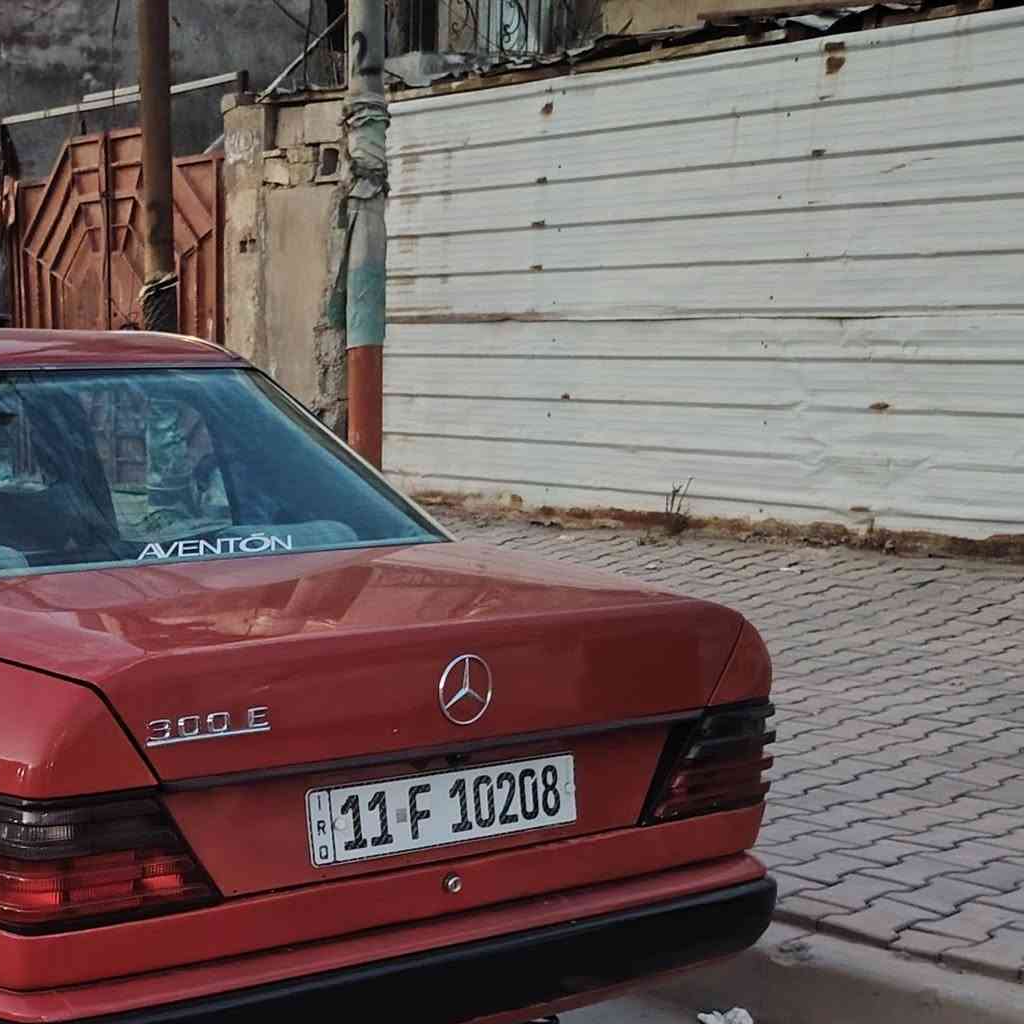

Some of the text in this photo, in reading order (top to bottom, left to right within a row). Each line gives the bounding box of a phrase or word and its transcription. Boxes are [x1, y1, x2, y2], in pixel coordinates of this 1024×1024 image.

[146, 706, 270, 741] 300 E
[340, 764, 562, 850] 11 F 10208
